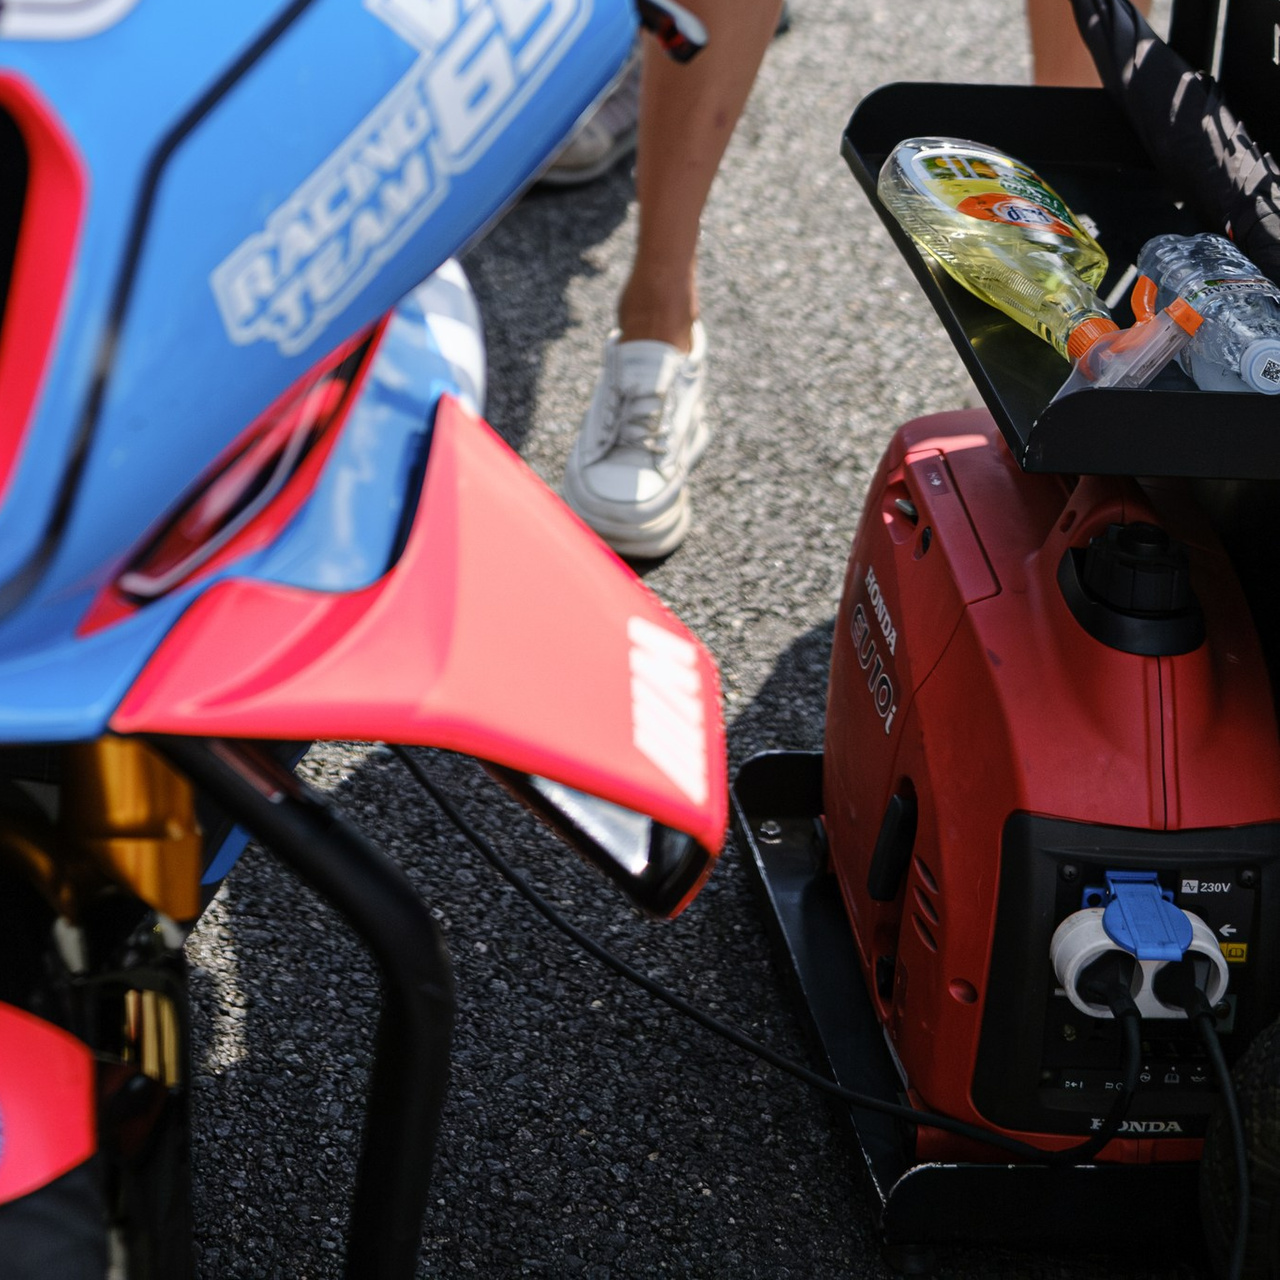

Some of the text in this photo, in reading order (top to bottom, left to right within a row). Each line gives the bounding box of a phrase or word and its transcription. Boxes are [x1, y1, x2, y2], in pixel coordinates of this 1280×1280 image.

[234, 100, 432, 316] RACING
[268, 151, 429, 336] TEAM
[851, 603, 897, 735] EU10i
[865, 565, 897, 656] HONDA
[1200, 882, 1231, 893] 230V
